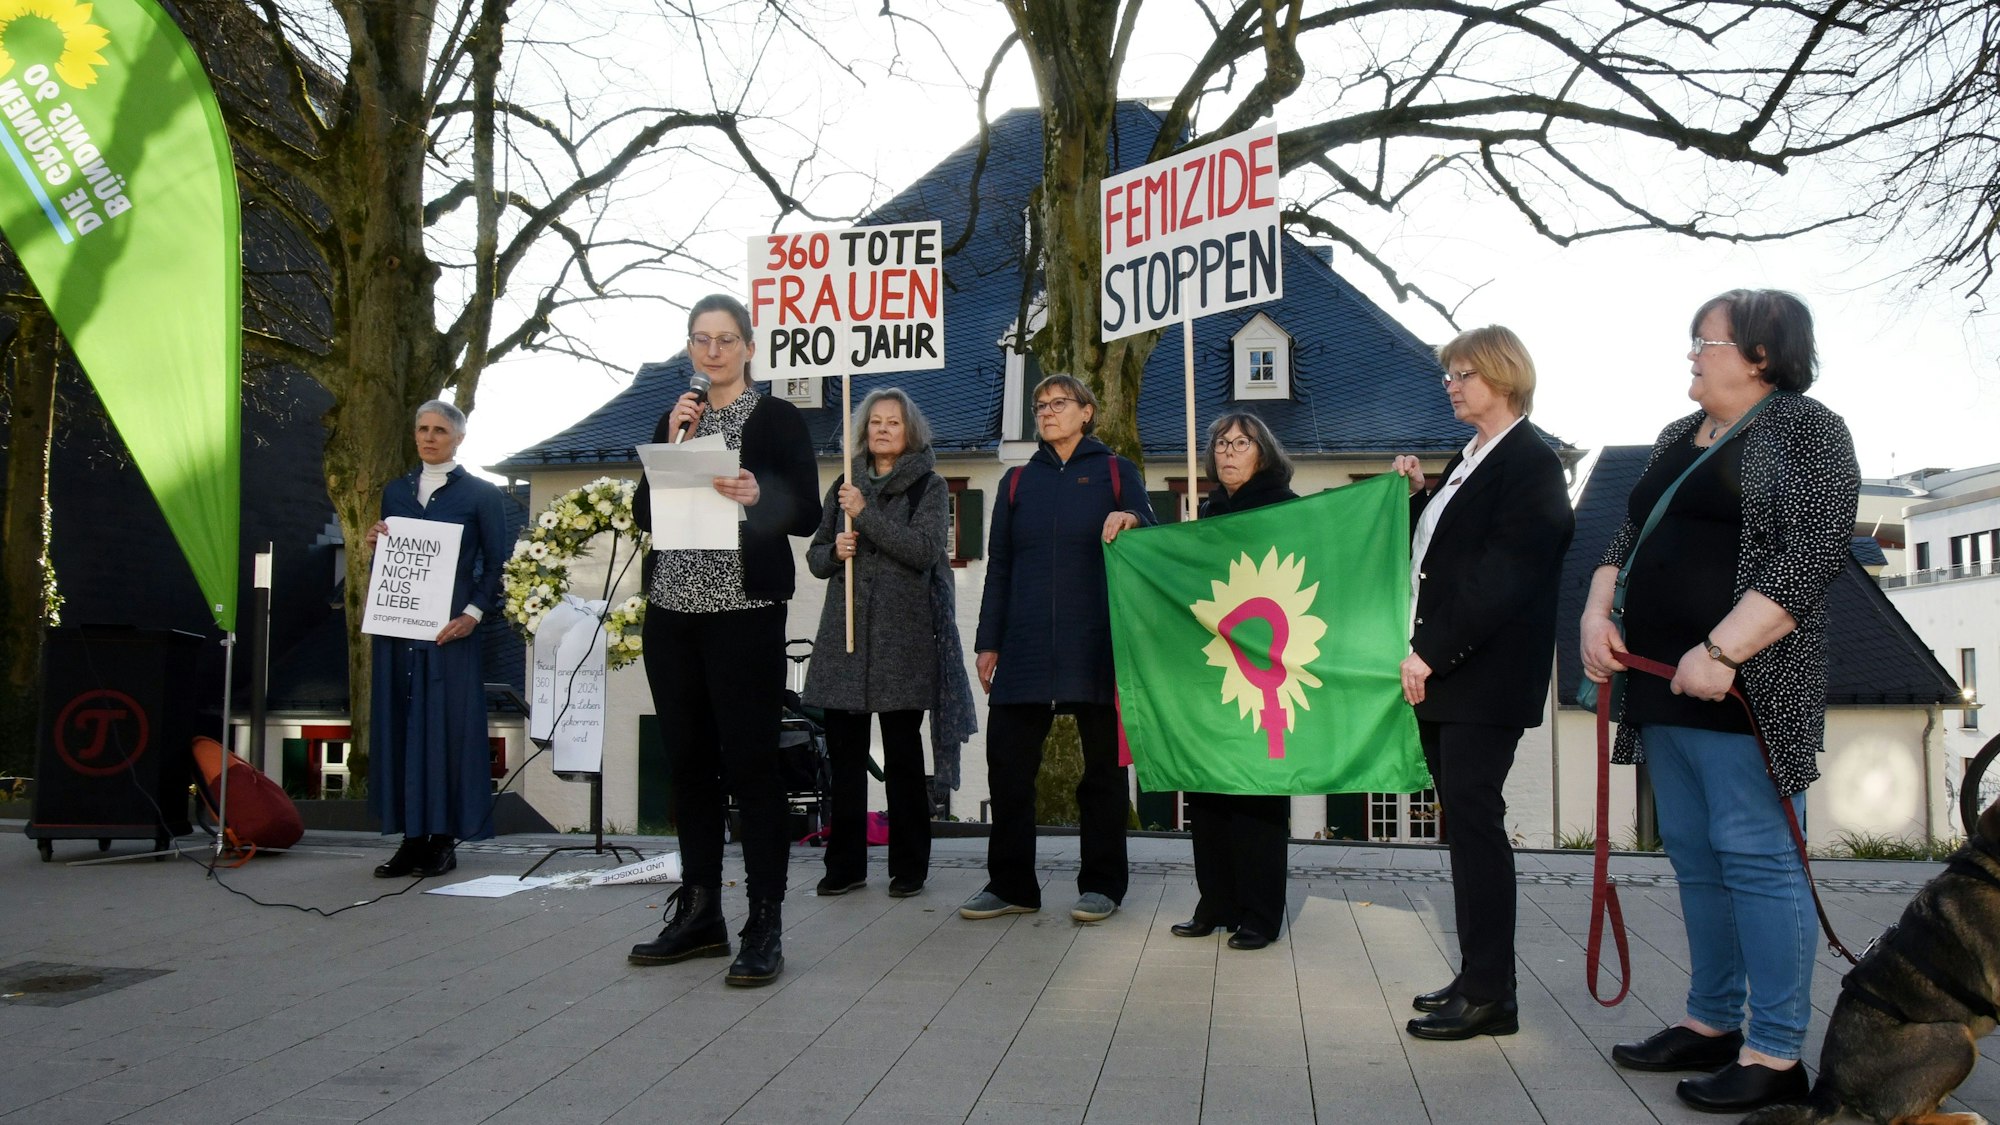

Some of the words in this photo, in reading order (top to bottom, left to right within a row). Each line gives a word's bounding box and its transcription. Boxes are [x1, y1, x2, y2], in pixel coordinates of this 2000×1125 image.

[1105, 136, 1275, 255] FEMIZIDE
[766, 232, 830, 271] 360
[839, 229, 937, 266] TOTE
[1103, 225, 1277, 332] STOPPEN
[752, 268, 938, 327] FRAUEN
[770, 325, 836, 368] PRO
[851, 322, 938, 367] JAHR
[386, 535, 441, 556] MAN(N)
[385, 549, 434, 567] TÖTET
[381, 564, 431, 581] NICHT
[377, 579, 412, 594] AUS
[376, 593, 421, 610] LIEBE
[372, 614, 402, 623] STOPPT
[402, 617, 439, 628] FEMIZIDE!
[577, 682, 598, 693] 2024
[646, 861, 665, 871] UND
[602, 867, 645, 883] TOXISCHE
